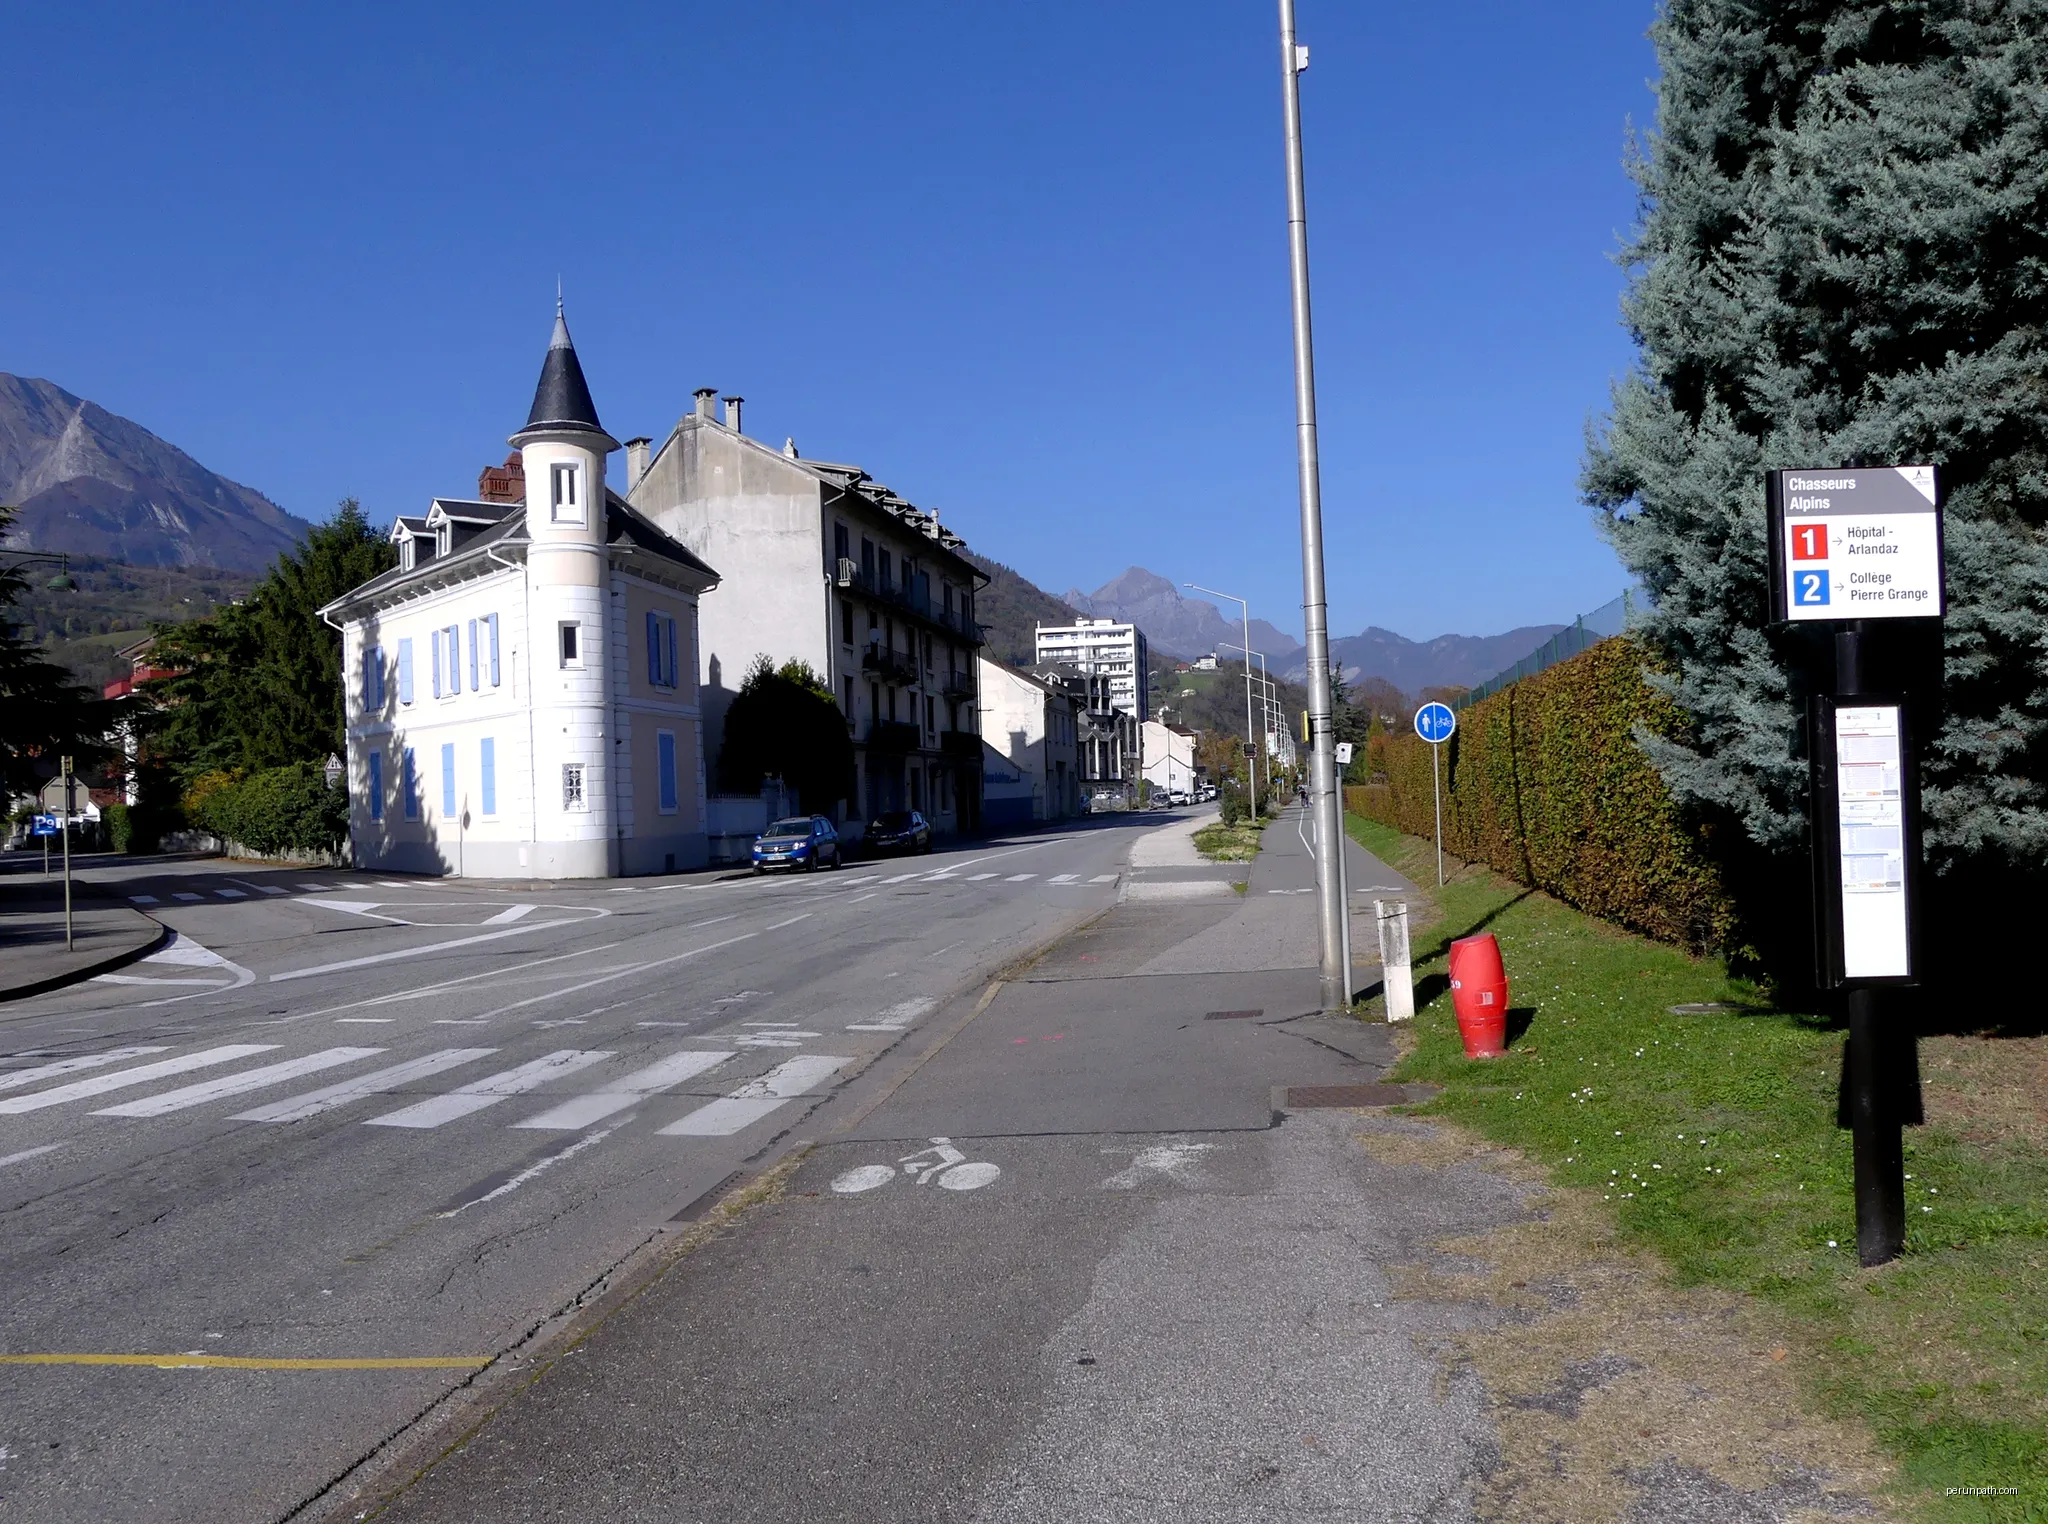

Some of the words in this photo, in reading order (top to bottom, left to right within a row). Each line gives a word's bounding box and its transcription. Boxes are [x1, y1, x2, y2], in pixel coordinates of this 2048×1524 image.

[1789, 477, 1856, 491] Chasseurs
[1789, 496, 1830, 512] Alpins
[1847, 526, 1885, 540] Hôpital
[1801, 528, 1815, 556] 1
[1848, 543, 1899, 555] Arlandaz
[1850, 571, 1892, 585] Collège
[1802, 574, 1821, 602] 2
[1850, 589, 1884, 601] Pierre
[1888, 588, 1928, 601] Grange
